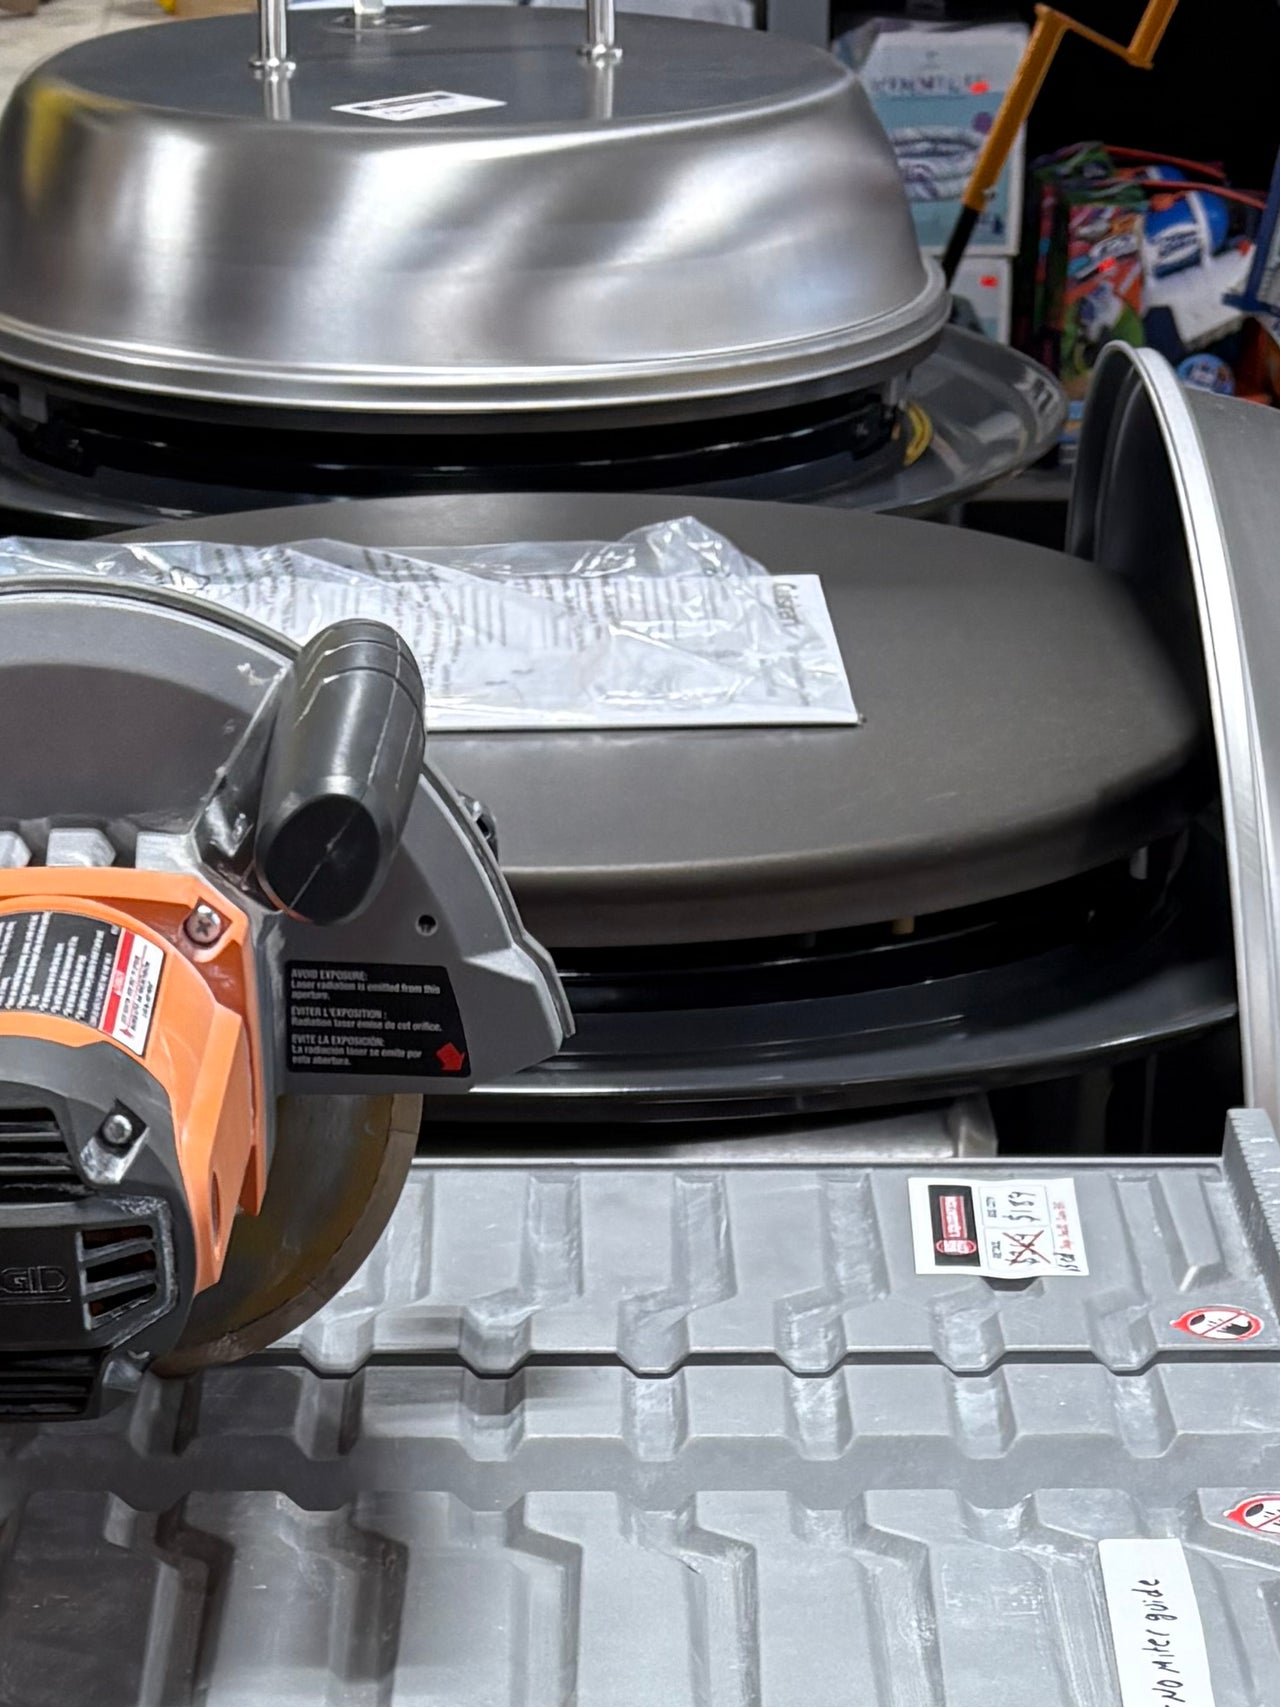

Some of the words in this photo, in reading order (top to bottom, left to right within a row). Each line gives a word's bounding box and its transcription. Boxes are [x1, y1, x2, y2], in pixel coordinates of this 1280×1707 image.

[291, 969, 318, 980] AVOID
[291, 980, 315, 990] Laser
[317, 982, 356, 991] radiation
[367, 982, 400, 993] emitted
[401, 984, 422, 993] from
[423, 984, 441, 994] this
[291, 1018, 332, 1027] Radiation
[334, 1019, 355, 1028] laser
[1131, 1578, 1178, 1621] guide
